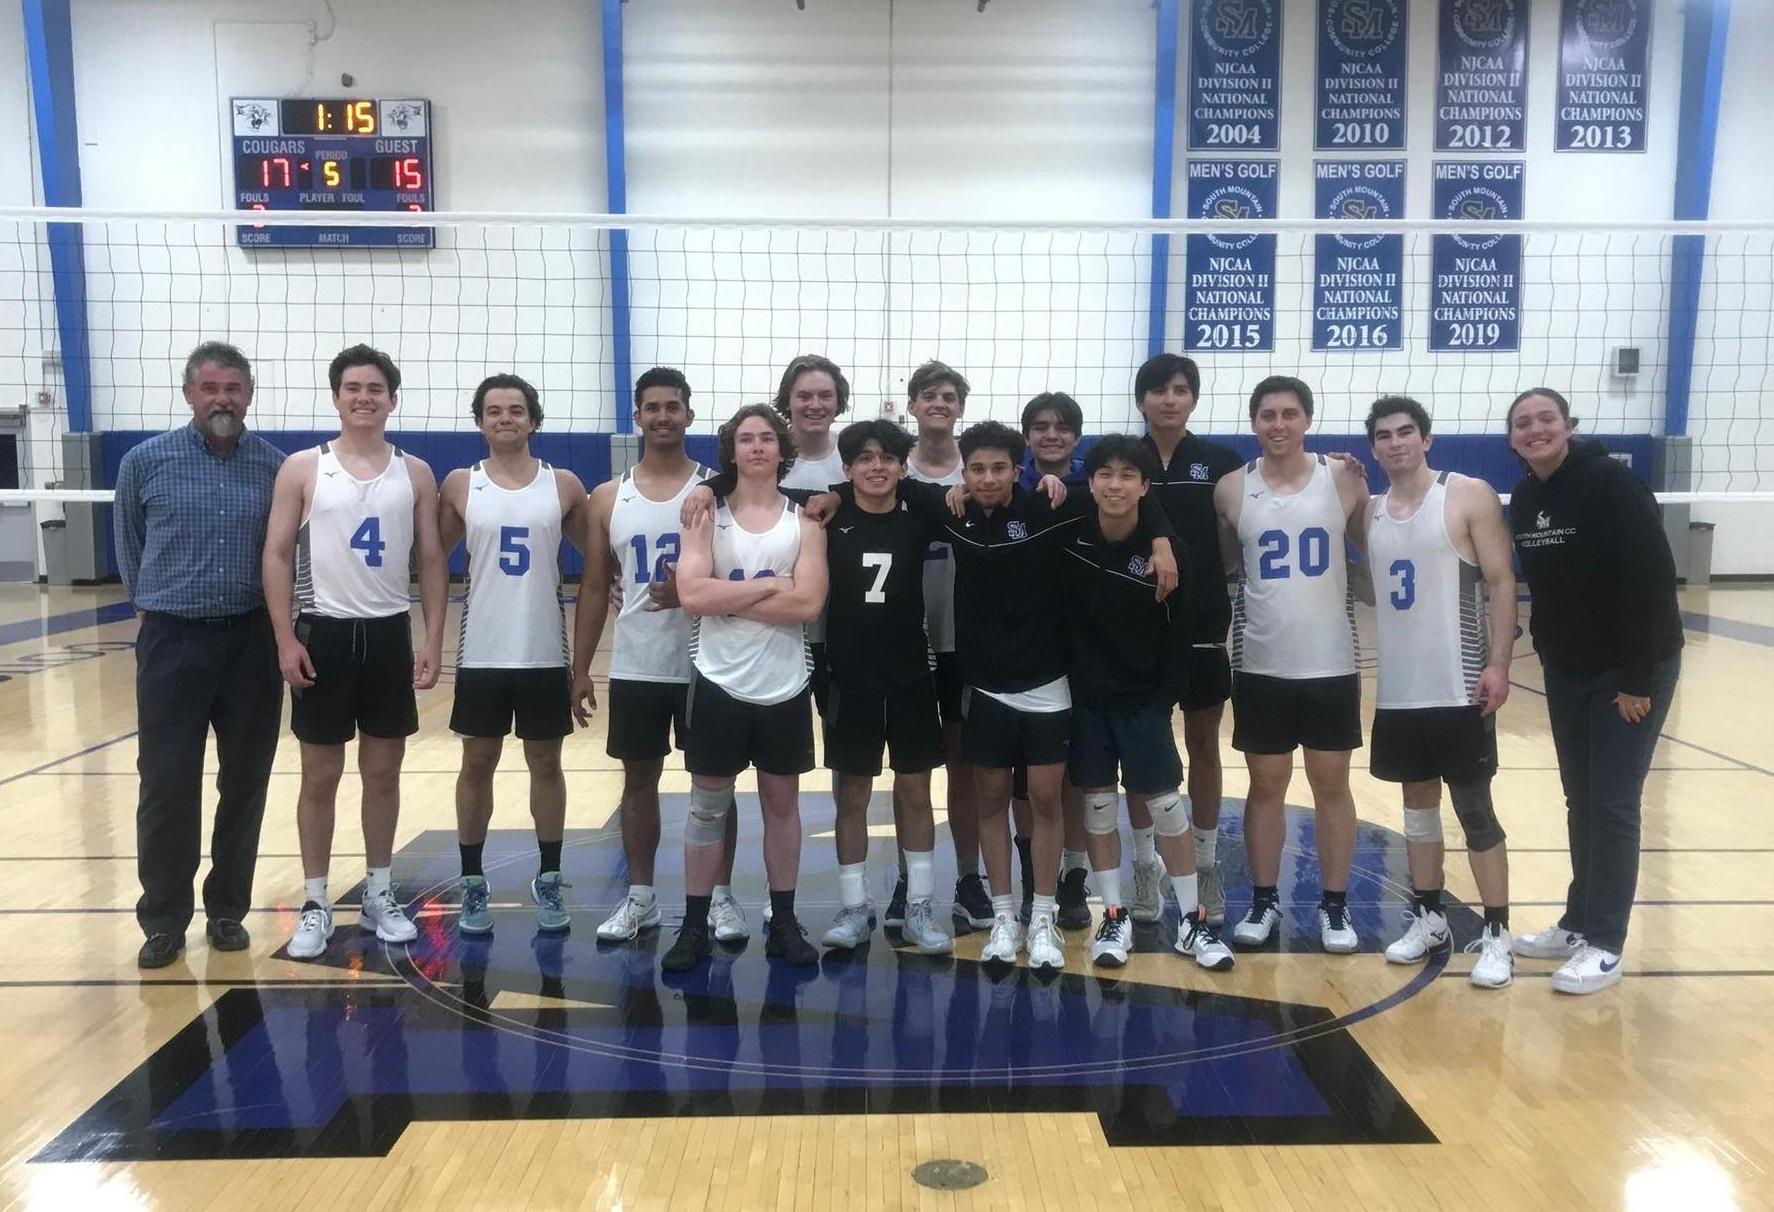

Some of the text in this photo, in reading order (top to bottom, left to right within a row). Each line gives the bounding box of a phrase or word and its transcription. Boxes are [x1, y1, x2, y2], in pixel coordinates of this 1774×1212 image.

[1214, 63, 1256, 75] NJCAA
[1341, 63, 1382, 75] NJCAA
[1461, 56, 1503, 71] NJCAA
[1584, 57, 1625, 71] NJCAA
[1198, 78, 1272, 89] DIVISION II
[1325, 78, 1398, 89] DIVISION II
[1444, 73, 1520, 87] DIVISION II
[1565, 74, 1641, 87] DIVISION II
[1202, 93, 1268, 104] NATIONAL
[1329, 93, 1394, 104] NATIONAL
[1448, 90, 1515, 103] NATIONAL
[1569, 91, 1637, 104] NATIONAL
[317, 101, 375, 134] 1:15
[1195, 109, 1275, 119] CHAMPIONS
[1321, 109, 1401, 119] CHAMPIONS
[1440, 106, 1522, 120] CHAMPIONS
[1561, 107, 1643, 120] CHAMPIONS
[1206, 125, 1262, 144] 2004
[1332, 123, 1389, 143] 2010
[1448, 125, 1512, 148] 2012
[1570, 126, 1632, 148] 2013
[242, 140, 306, 154] COUGARS
[375, 139, 418, 153] GUEST
[315, 151, 348, 160] PERIOD
[262, 158, 291, 187] 17
[323, 160, 341, 187] 5
[393, 158, 423, 189] 15
[1189, 164, 1277, 178] MEN'S GOLF
[1317, 164, 1403, 178] MEN'S GOLF
[1436, 165, 1522, 179] MEN'S GOLF
[240, 193, 270, 202] FOULS
[300, 193, 365, 202] PLAYER FOUL
[396, 193, 425, 202] FOULS
[1202, 185, 1263, 212] SOUTH MOUNTAIN
[1329, 185, 1390, 212] SOUTH MOUNTAIN
[1448, 186, 1508, 213] SOUTH MOUNTAIN
[241, 234, 271, 243] SCORE
[318, 234, 350, 243] MATCH
[396, 234, 426, 243] SCORE
[1209, 257, 1252, 271] NJCAA
[1337, 257, 1380, 270] NJCAA
[1455, 258, 1497, 273] NJCAA
[1192, 275, 1268, 287] DIVISION II
[1320, 274, 1396, 287] DIVISION II
[1438, 274, 1514, 287] DIVISION II
[1196, 291, 1264, 304] NATIONAL
[1324, 290, 1392, 303] NATIONAL
[1442, 291, 1509, 304] NATIONAL
[1189, 308, 1271, 320] CHAMPIONS
[1316, 307, 1399, 319] CHAMPIONS
[1434, 307, 1516, 320] CHAMPIONS
[1196, 324, 1261, 347] 2015
[1326, 324, 1388, 346] 2016
[1449, 323, 1500, 345] 2019
[1532, 528, 1564, 539] MOUNTAIN
[350, 517, 386, 567] 4
[500, 526, 530, 576] 5
[631, 533, 681, 583] 12
[1258, 527, 1330, 579] 20
[862, 552, 893, 603] 7
[1390, 559, 1416, 610] 3
